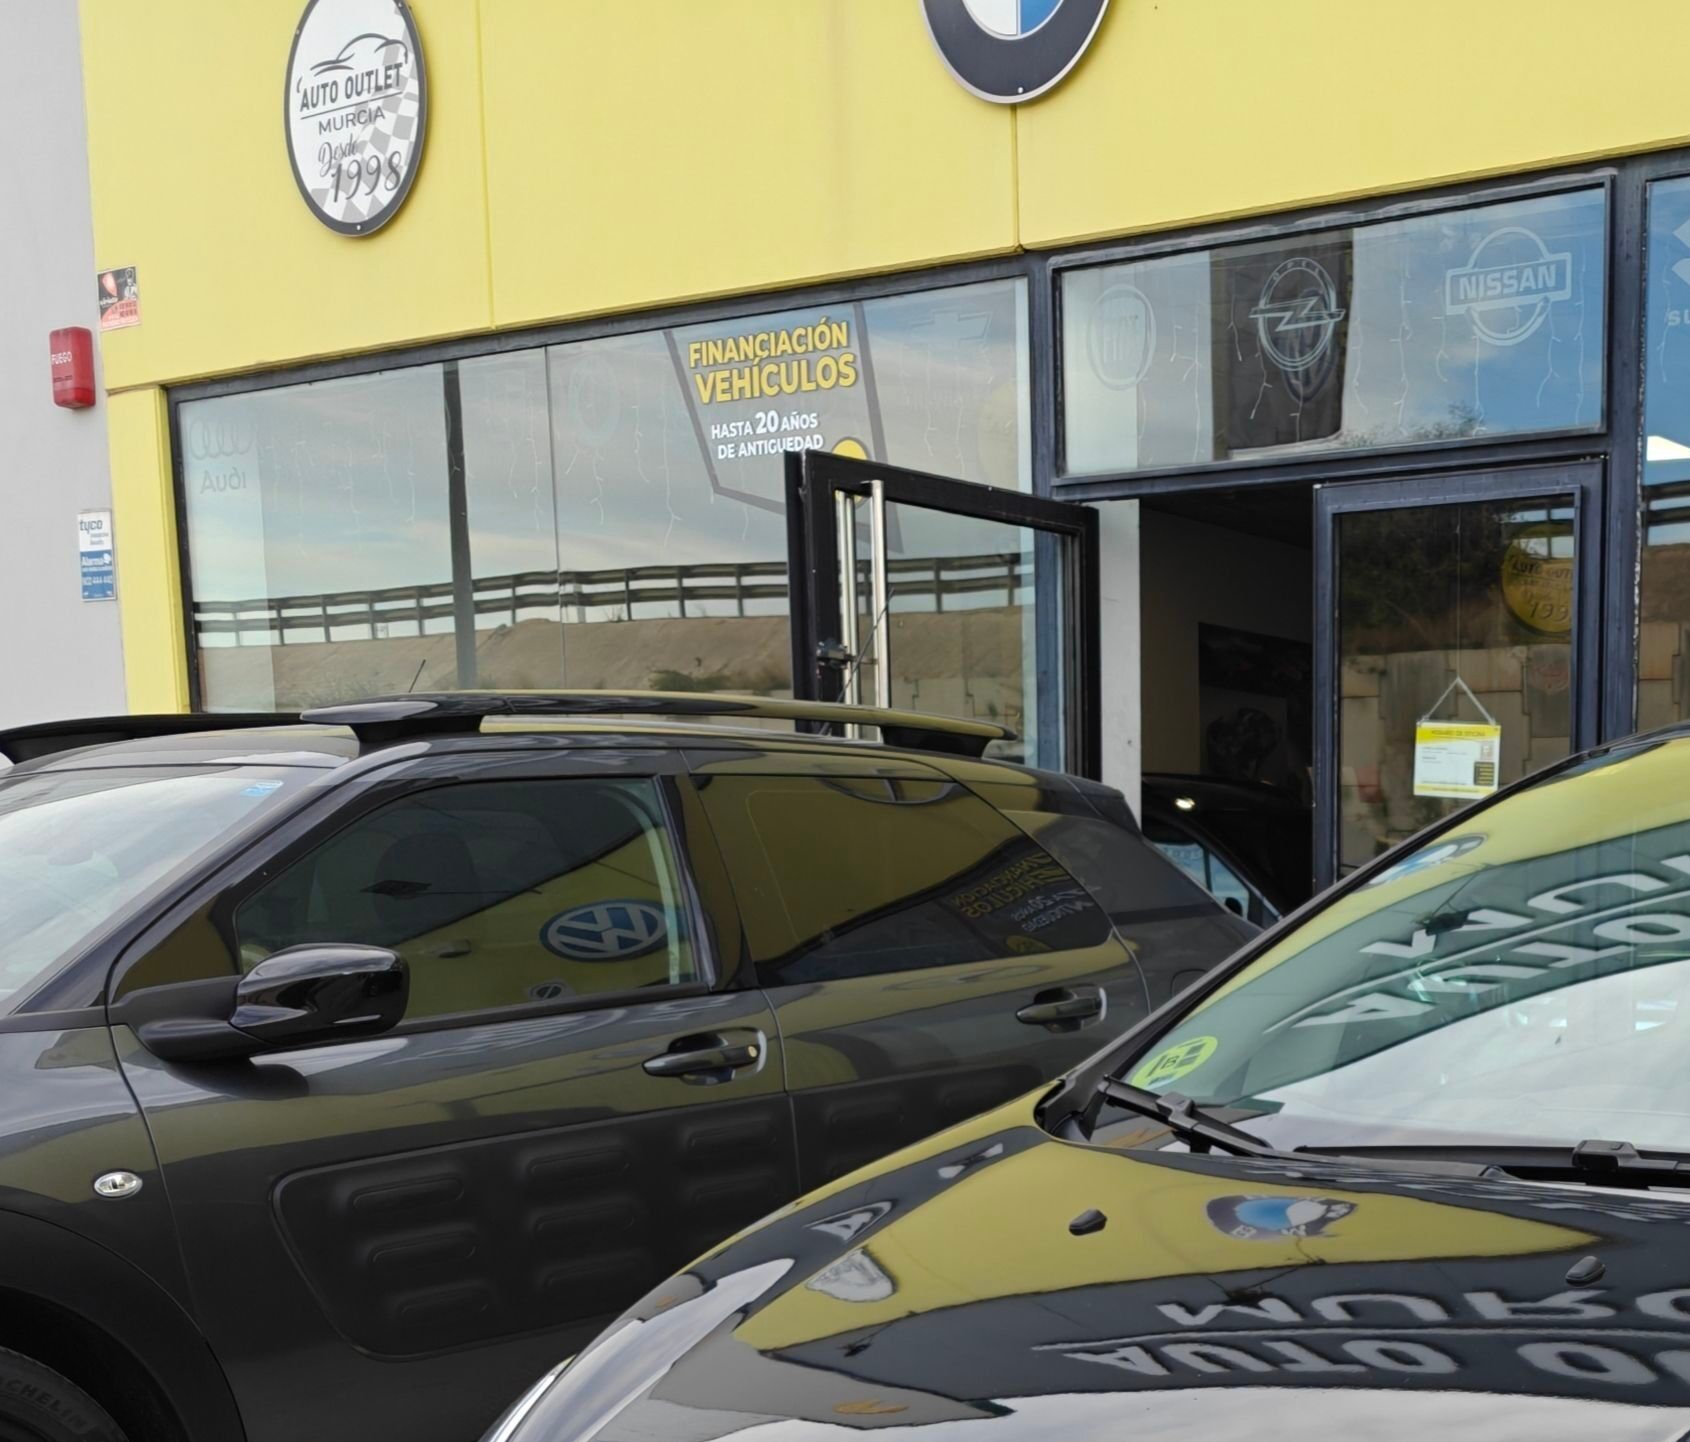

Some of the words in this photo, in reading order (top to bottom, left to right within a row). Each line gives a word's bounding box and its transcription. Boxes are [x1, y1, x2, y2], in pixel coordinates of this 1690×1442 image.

[300, 80, 339, 112] AUTO
[345, 63, 403, 99] OUTLET
[318, 105, 386, 135] MURCIA
[331, 150, 402, 203] 1998
[1459, 263, 1556, 299] NISSAN
[688, 316, 848, 368] FINANCIACIÓN
[694, 352, 857, 404] VEHÍCULOS
[711, 421, 754, 439] HASTA
[755, 410, 779, 434] 20
[780, 412, 818, 429] AÑOS
[718, 444, 736, 459] DE
[738, 434, 823, 454] ANTIGUEDAD
[200, 466, 247, 494] Audi
[80, 519, 103, 534] tyco
